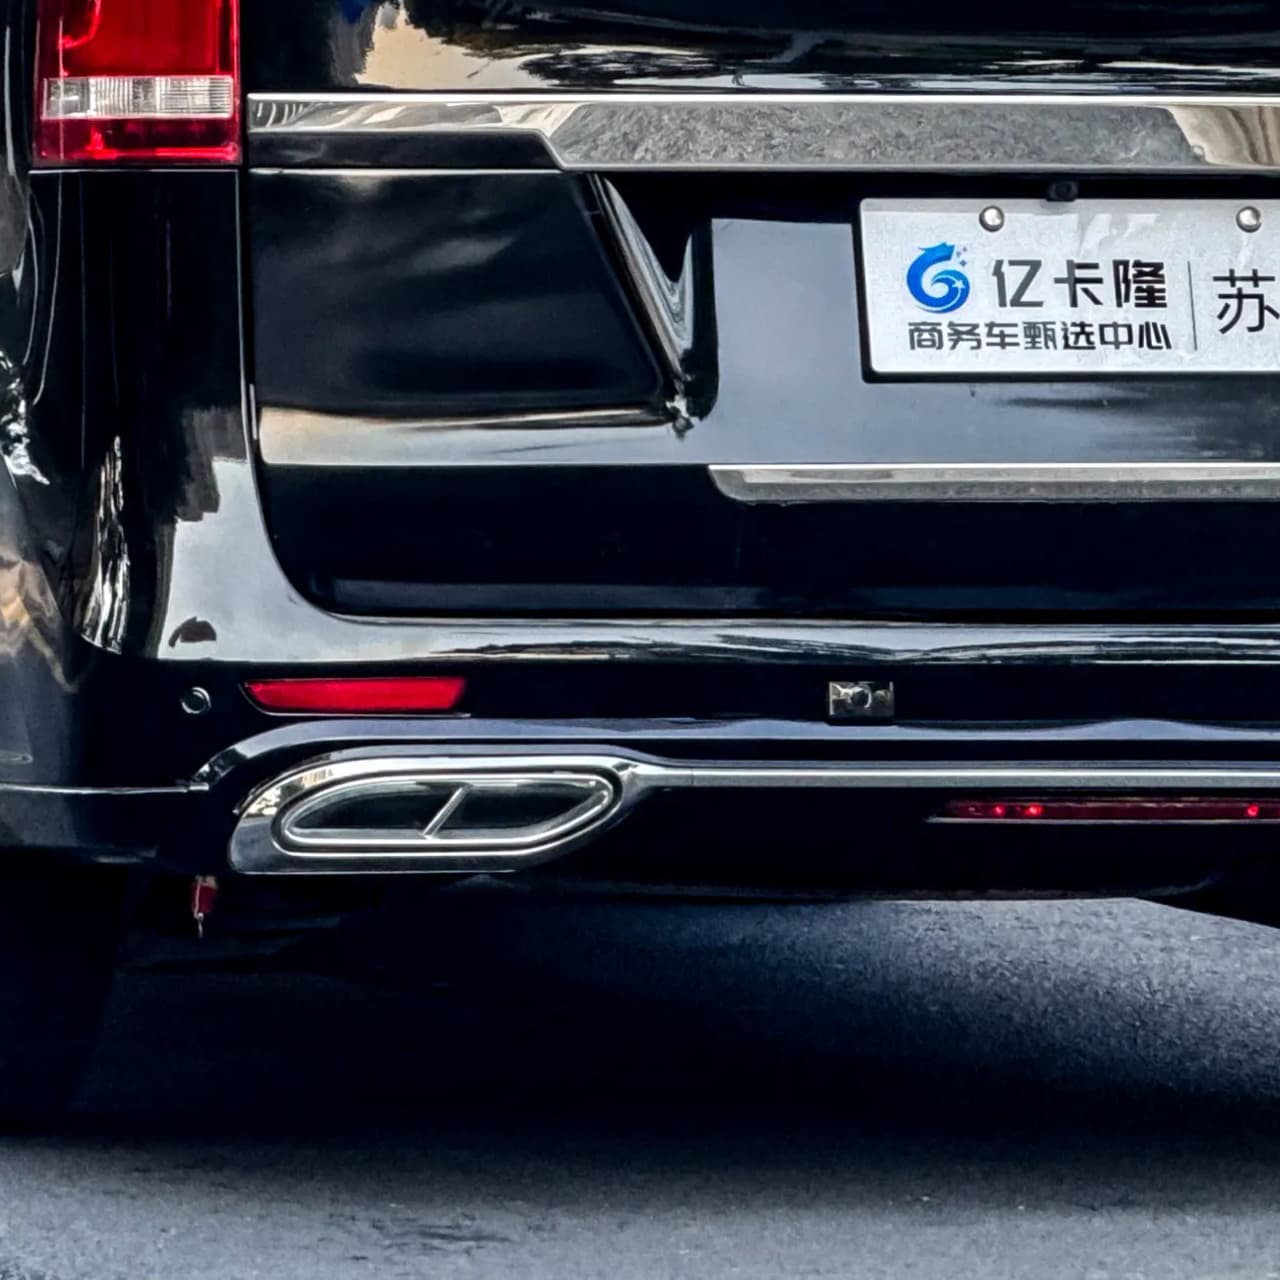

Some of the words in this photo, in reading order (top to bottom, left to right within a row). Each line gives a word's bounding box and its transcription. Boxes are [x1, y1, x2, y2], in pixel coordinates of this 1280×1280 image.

[992, 259, 1168, 309] 亿卡隆
[907, 321, 1172, 351] 商务车甄选中心
